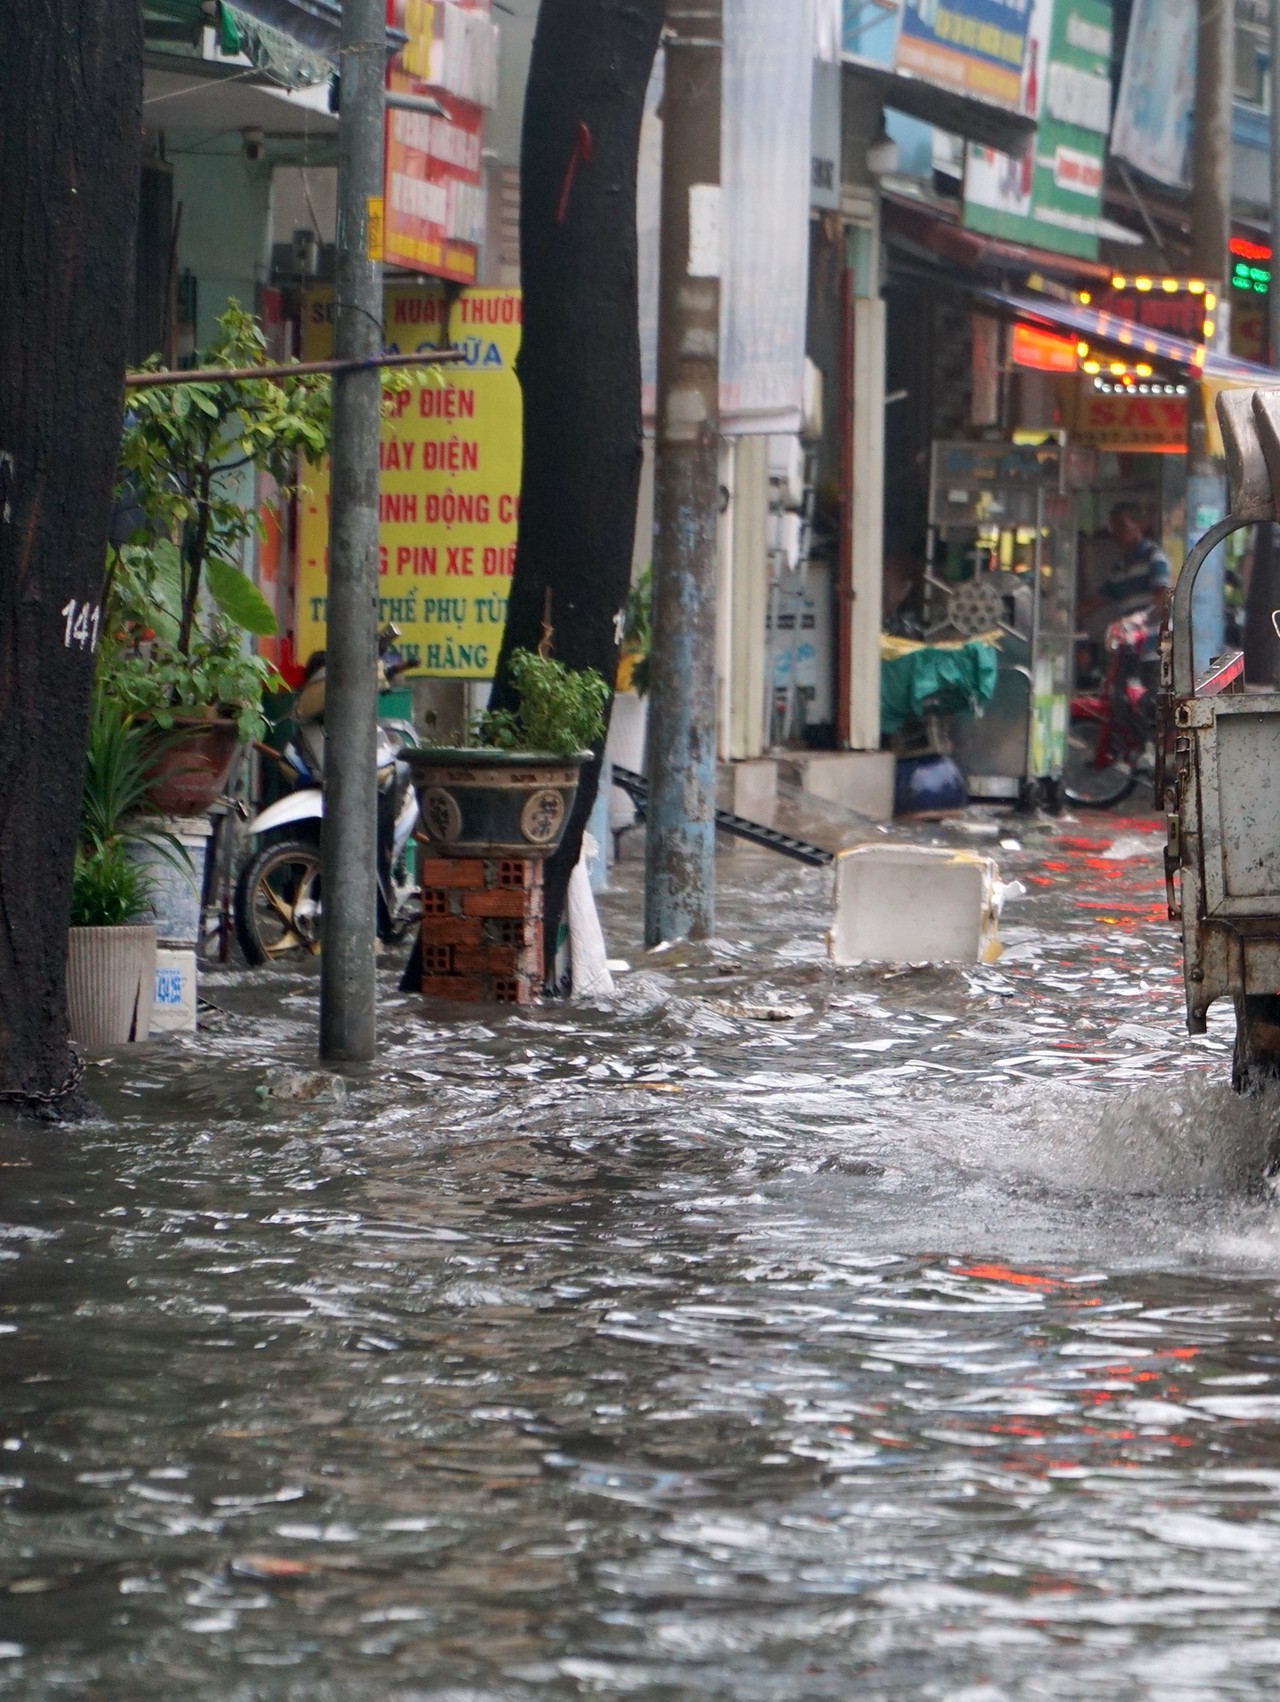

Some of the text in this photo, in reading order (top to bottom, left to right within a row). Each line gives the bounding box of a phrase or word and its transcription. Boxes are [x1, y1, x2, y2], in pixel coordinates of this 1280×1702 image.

[419, 383, 475, 425] ĐIỆN
[422, 435, 479, 477] ĐIỆN
[425, 488, 490, 530] ĐỘNG
[497, 494, 521, 524] C
[396, 546, 437, 576] PIN
[445, 547, 474, 576] XE
[61, 598, 100, 653] 141
[424, 597, 467, 632] PHỤ
[474, 591, 508, 624] TÙ
[426, 636, 489, 670] HÃNG
